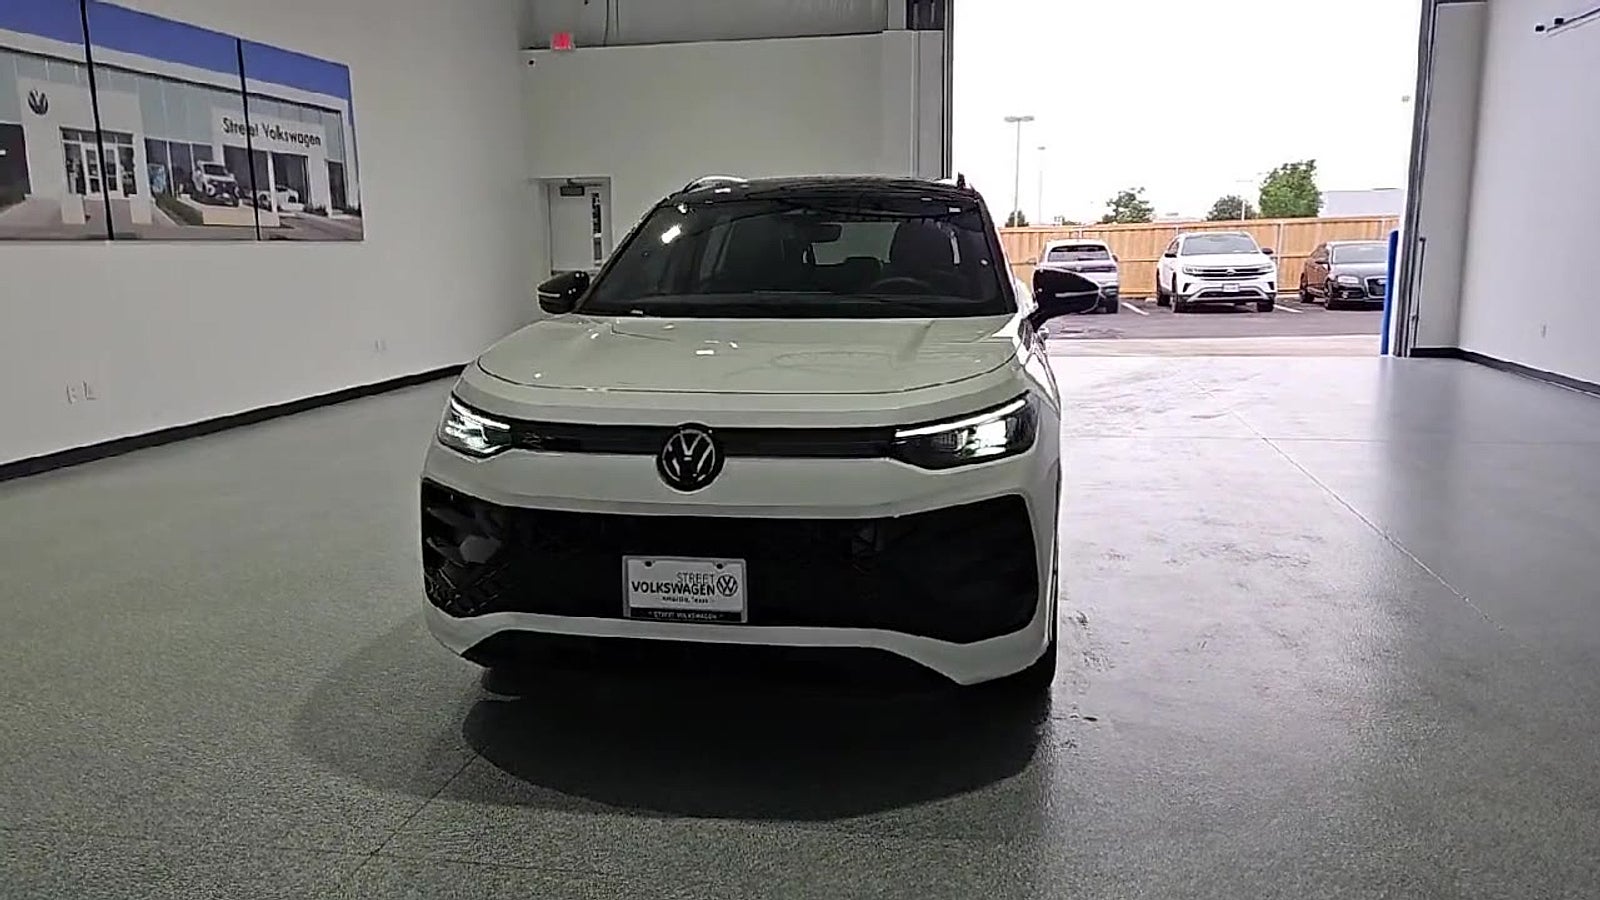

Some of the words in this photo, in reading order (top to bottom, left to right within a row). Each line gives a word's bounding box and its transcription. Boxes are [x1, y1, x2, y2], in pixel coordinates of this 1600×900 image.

[222, 117, 259, 137] Street
[262, 123, 321, 148] Volkswagen
[677, 572, 715, 584] STREET
[631, 581, 715, 596] VOLKSWAGEN
